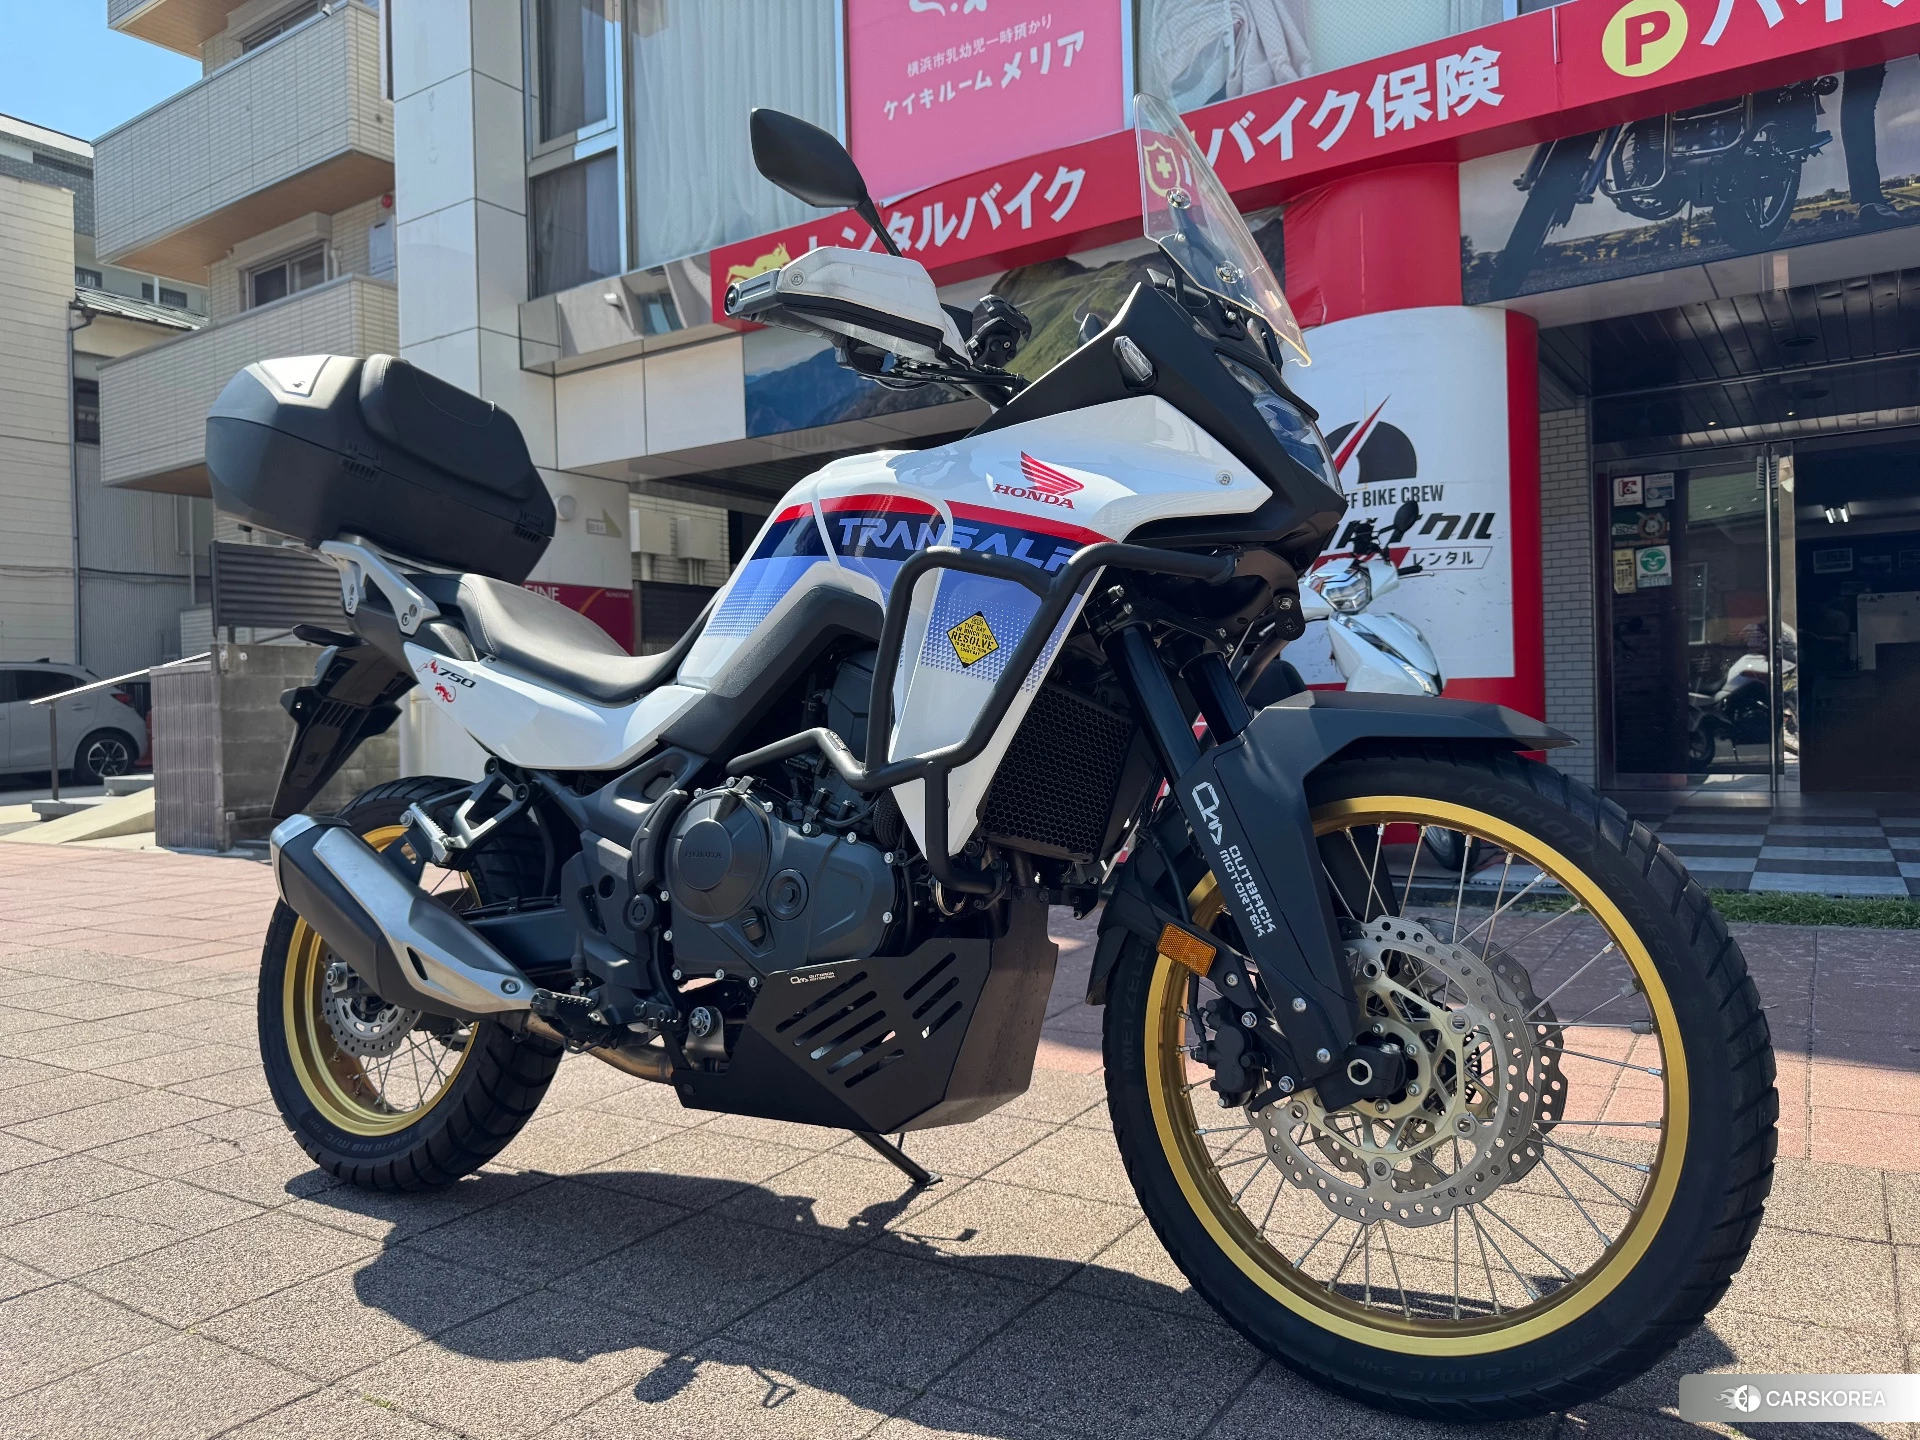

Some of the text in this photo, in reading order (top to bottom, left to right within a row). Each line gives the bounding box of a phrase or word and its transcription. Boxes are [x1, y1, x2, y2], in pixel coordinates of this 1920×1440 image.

[907, 13, 1052, 78] 横浜市乳幼児一時預かり
[1624, 10, 1671, 67] P
[883, 30, 1085, 121] ケイキルーム メリア
[1190, 44, 1504, 175] バイク保険
[993, 483, 1075, 510] HONDA
[1362, 487, 1396, 508] BIKE
[1400, 484, 1444, 503] CREW
[1413, 551, 1474, 566] レンタル
[951, 630, 994, 651] RESOLVE
[438, 667, 477, 688] 750
[1228, 844, 1277, 933] OUTBACK
